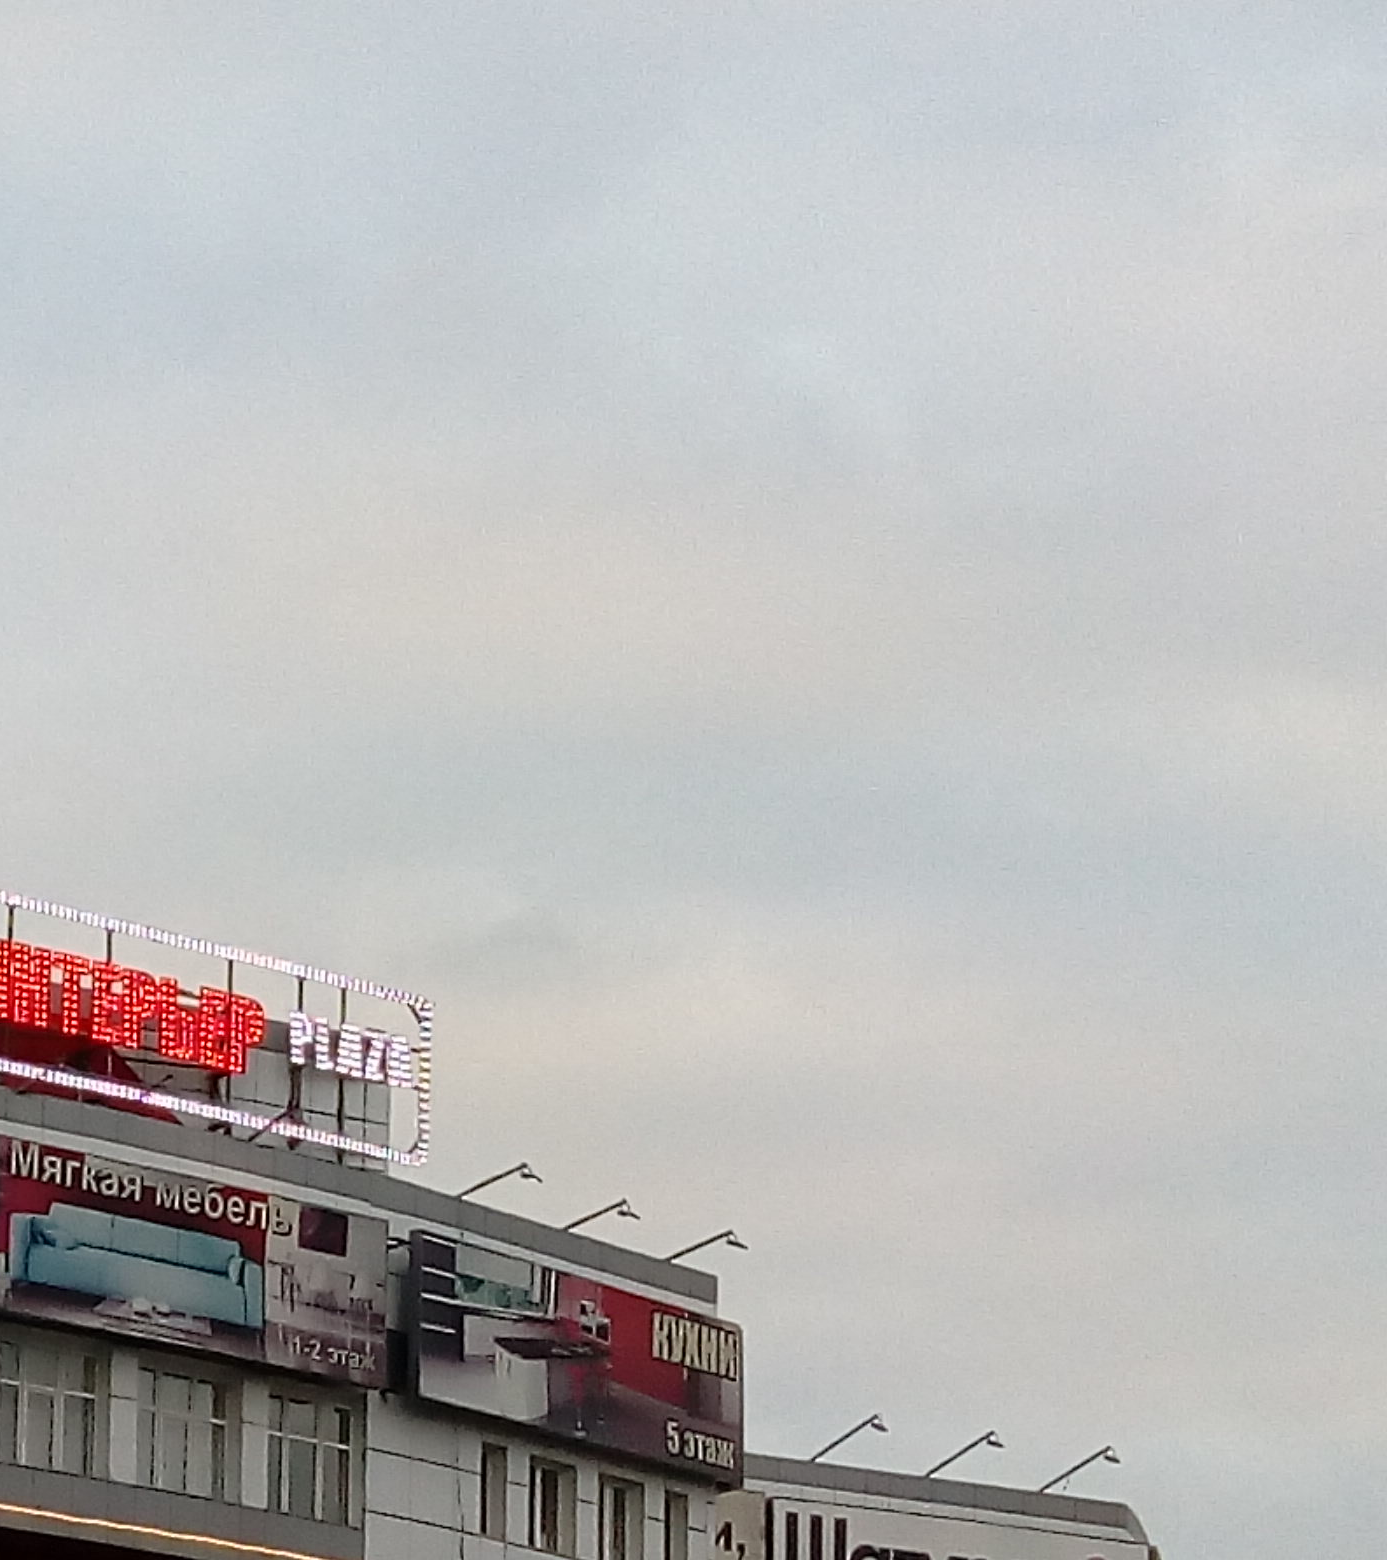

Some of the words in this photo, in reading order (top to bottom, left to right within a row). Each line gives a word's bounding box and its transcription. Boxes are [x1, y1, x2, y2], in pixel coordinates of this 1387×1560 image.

[10, 1141, 143, 1202] Мягкая
[155, 1180, 292, 1237] мебель
[327, 1347, 376, 1371] этаж
[652, 1311, 738, 1380] КУХНИ
[666, 1420, 680, 1455] 5
[683, 1429, 735, 1470] этаж
